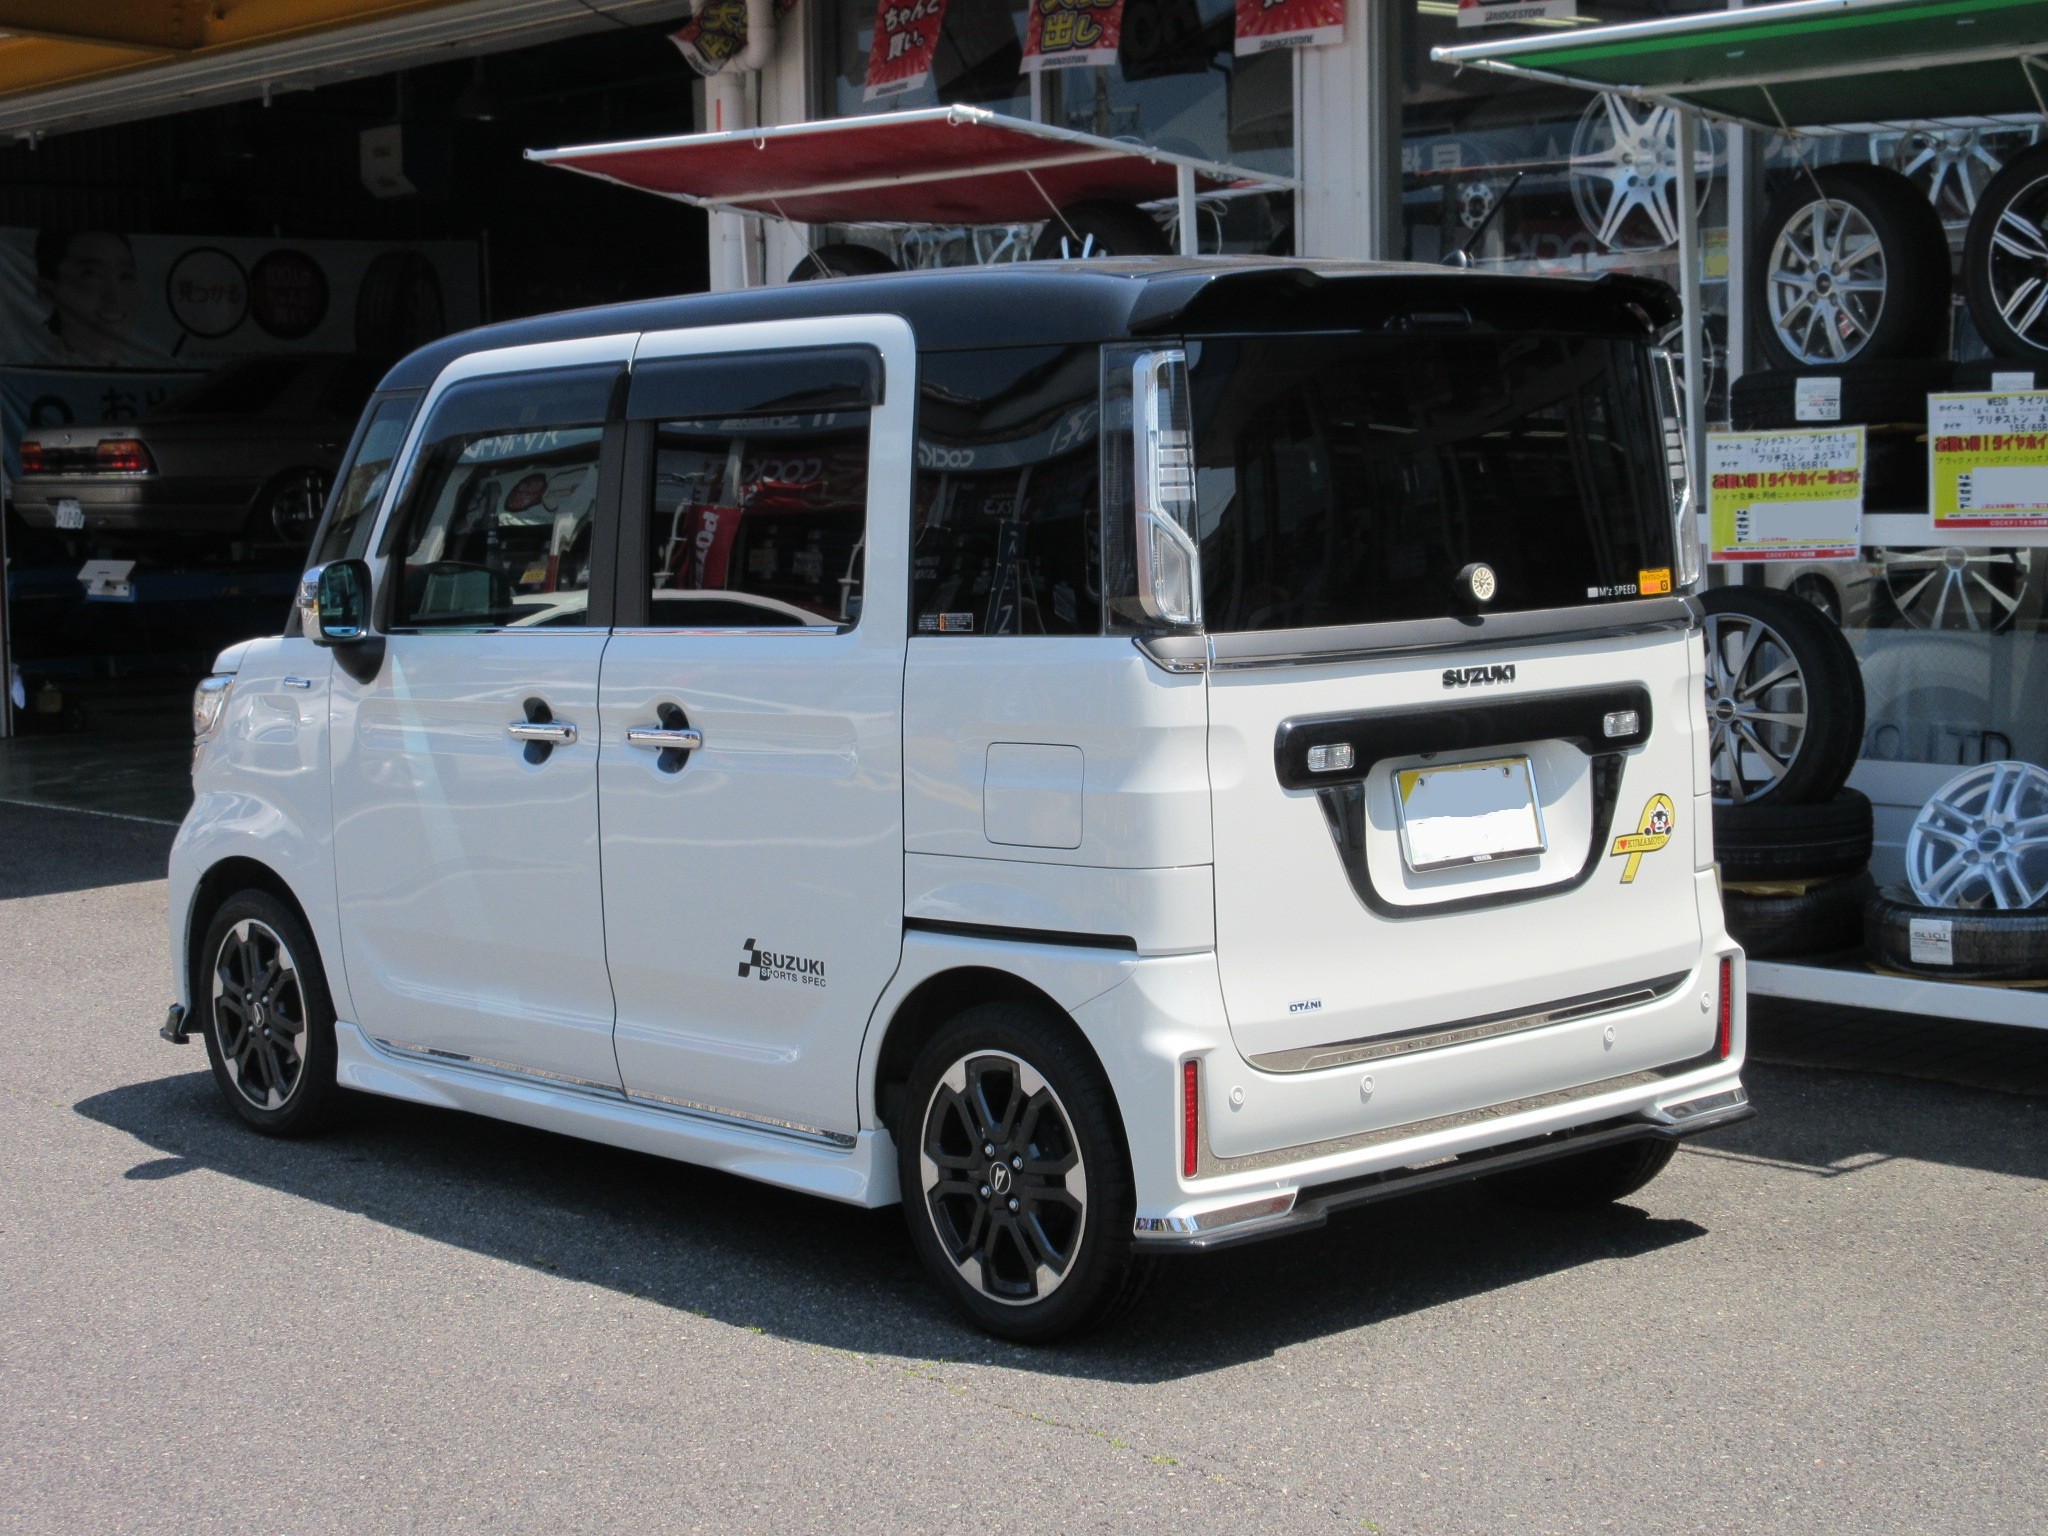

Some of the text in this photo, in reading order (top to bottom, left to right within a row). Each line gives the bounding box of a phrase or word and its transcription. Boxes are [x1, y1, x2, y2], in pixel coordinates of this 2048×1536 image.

[1485, 7, 1546, 21] BRIDGESTONE
[1043, 12, 1102, 50] 出し
[1599, 586, 1612, 596] M'z
[1614, 584, 1637, 595] SPEED
[1442, 664, 1516, 686] SUZUKI
[1628, 835, 1666, 848] KUMAMOTO
[762, 951, 825, 976] SUZUKI
[761, 967, 826, 987] SPORTS SPEC
[1289, 1000, 1322, 1012] OTANI
